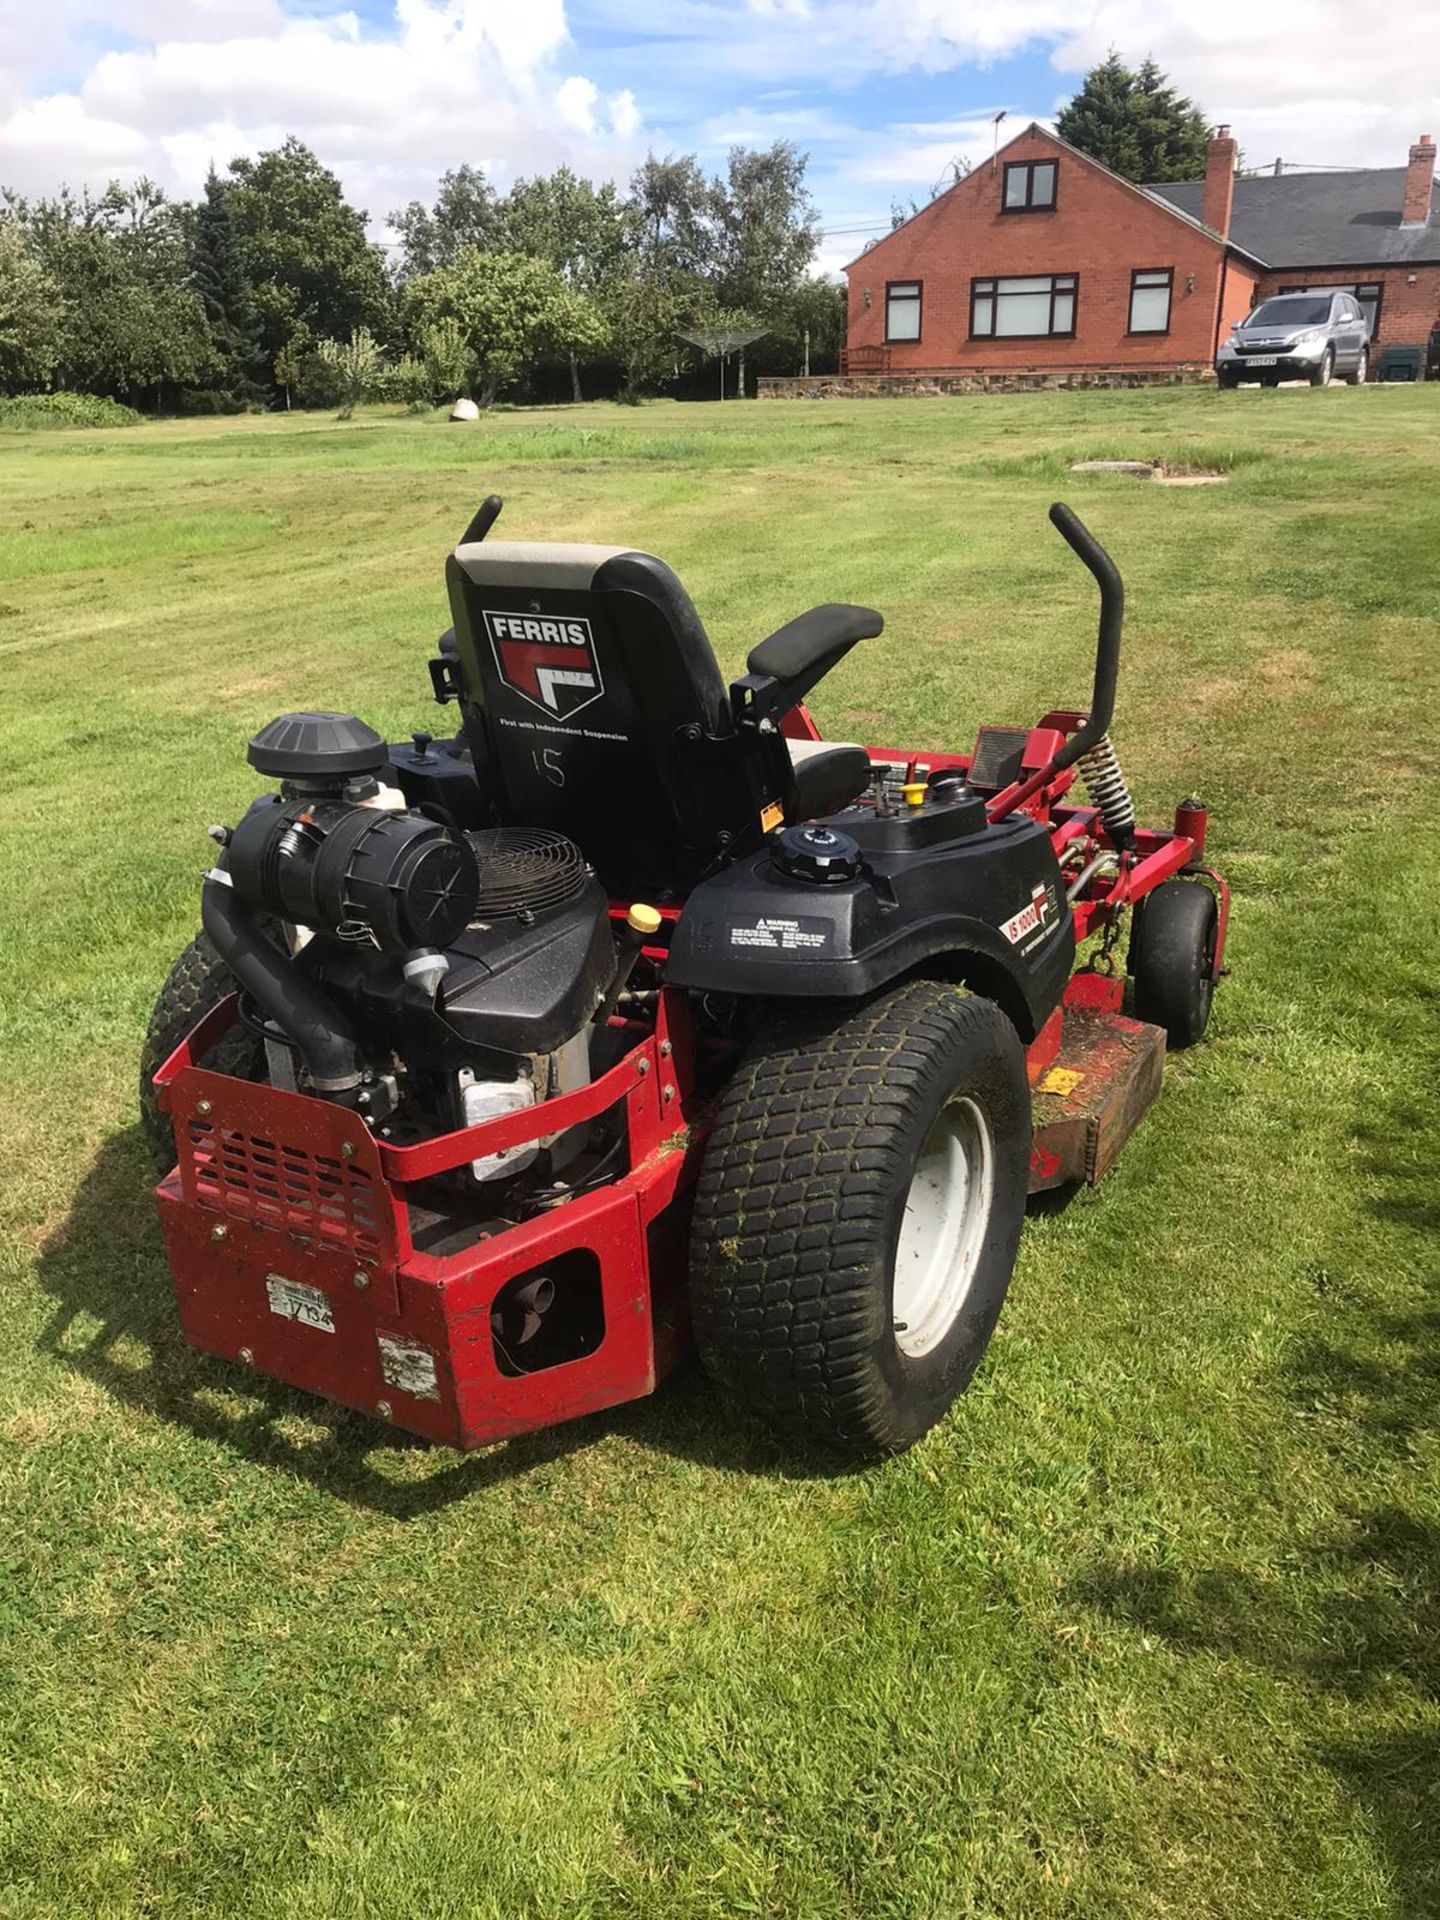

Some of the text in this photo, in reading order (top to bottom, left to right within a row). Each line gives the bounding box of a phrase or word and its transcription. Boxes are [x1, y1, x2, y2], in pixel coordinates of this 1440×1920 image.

[492, 617, 586, 645] FERRIS
[499, 718, 628, 741] First with Independent Suspension
[766, 919, 798, 928] WARNING
